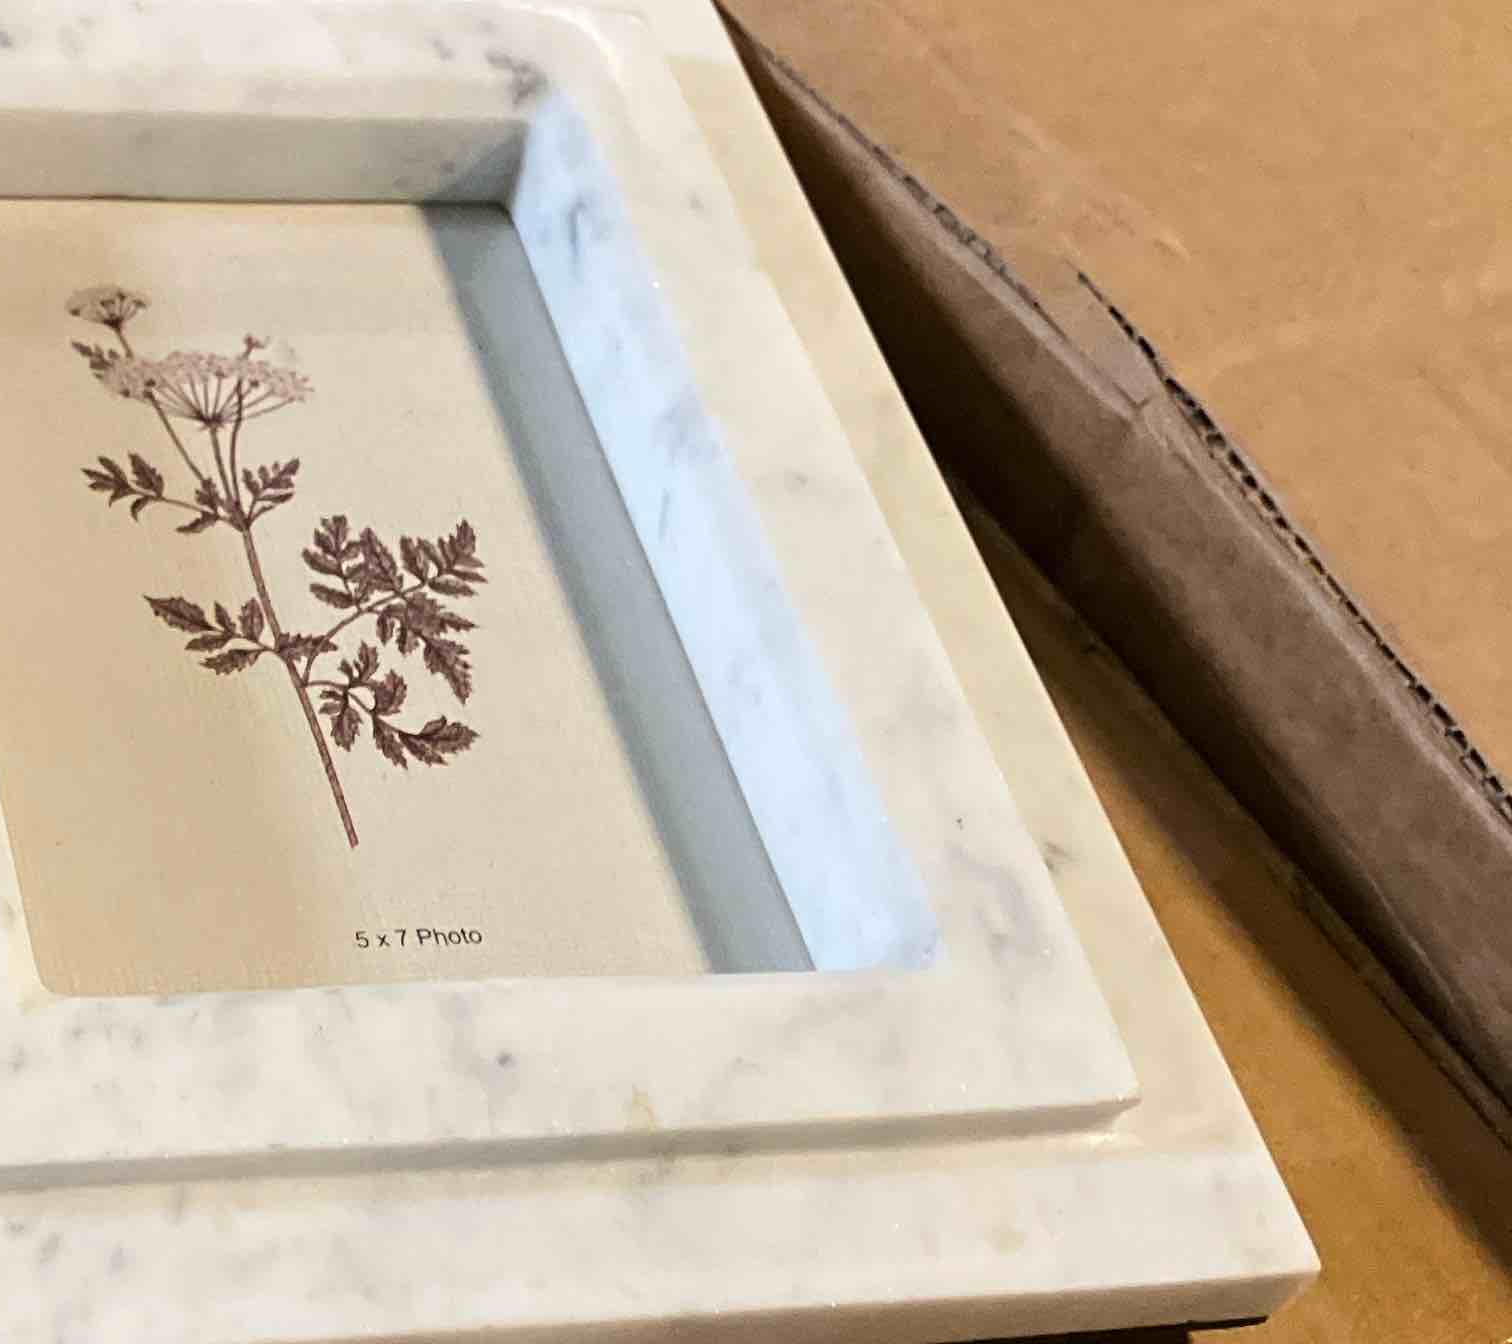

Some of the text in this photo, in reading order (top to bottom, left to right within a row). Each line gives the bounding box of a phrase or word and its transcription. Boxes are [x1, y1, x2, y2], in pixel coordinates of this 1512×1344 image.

[355, 927, 483, 948] 5 x 7 Photo
